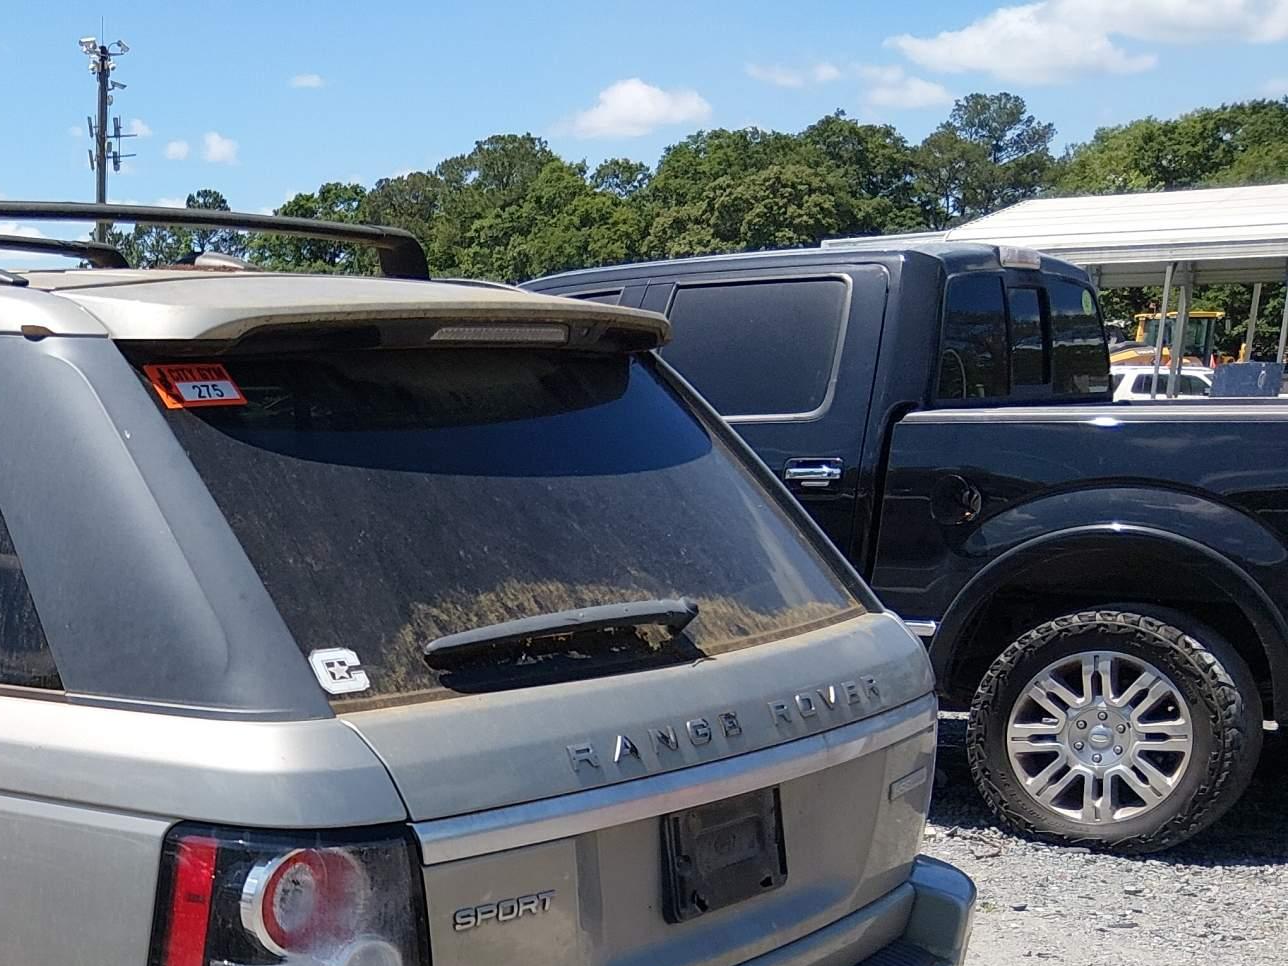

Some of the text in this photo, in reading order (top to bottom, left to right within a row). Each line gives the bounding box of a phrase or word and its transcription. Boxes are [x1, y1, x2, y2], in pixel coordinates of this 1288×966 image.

[192, 384, 224, 399] 275
[565, 674, 881, 772] RANGE ROVER
[453, 889, 556, 931] SPORT
